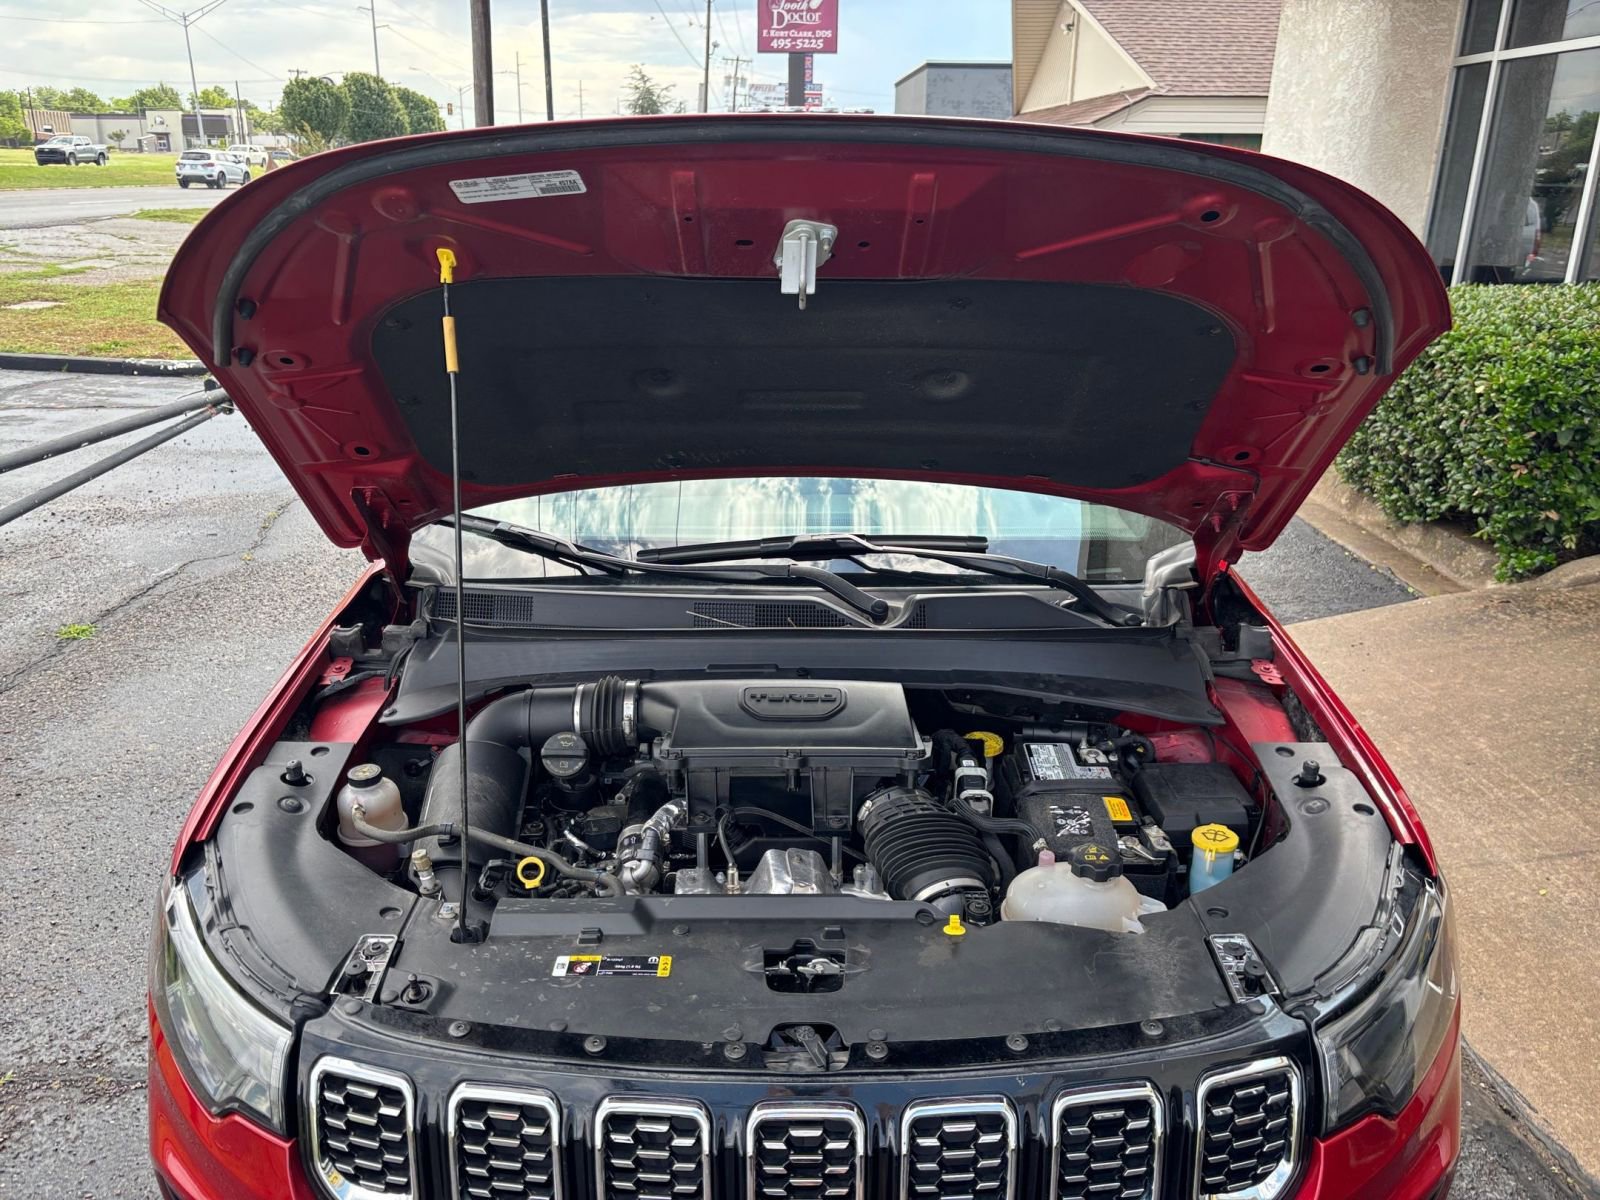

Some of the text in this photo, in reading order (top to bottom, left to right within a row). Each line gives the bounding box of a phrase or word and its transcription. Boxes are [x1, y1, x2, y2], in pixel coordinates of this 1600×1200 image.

[771, 9, 822, 29] Doctor
[815, 30, 832, 38] DDS
[770, 38, 824, 49] 495-5225
[750, 693, 837, 703] TURBO
